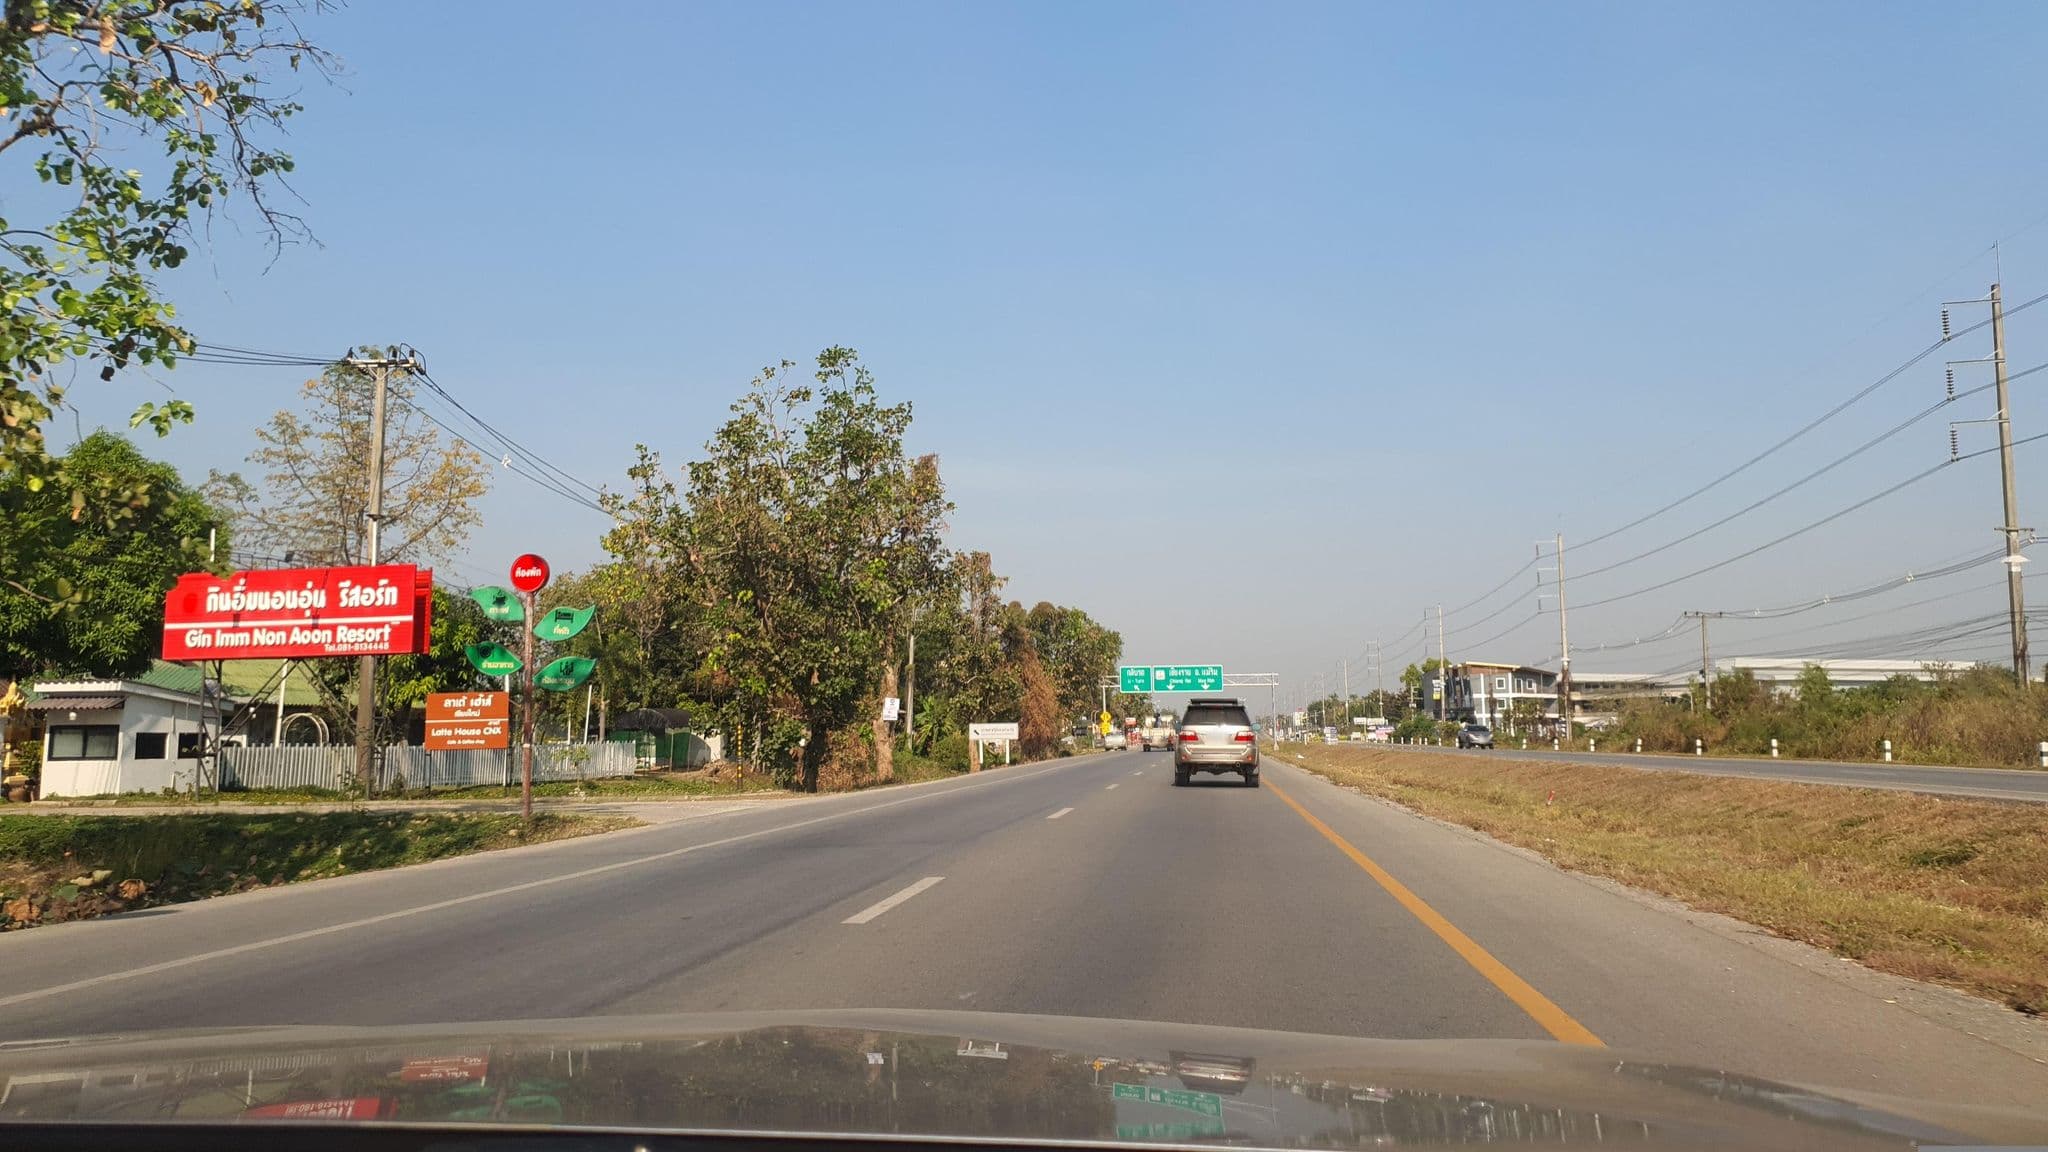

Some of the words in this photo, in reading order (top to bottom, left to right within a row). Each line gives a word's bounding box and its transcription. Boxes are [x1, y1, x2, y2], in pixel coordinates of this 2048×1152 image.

[206, 578, 326, 617] กินอิ่มนอนอุ่น
[185, 628, 212, 648] Gin
[215, 629, 250, 648] Imm
[253, 627, 287, 646] Non
[289, 626, 332, 646] Aoon
[336, 623, 391, 644] Resort
[431, 727, 453, 737] Latte
[454, 727, 482, 736] House
